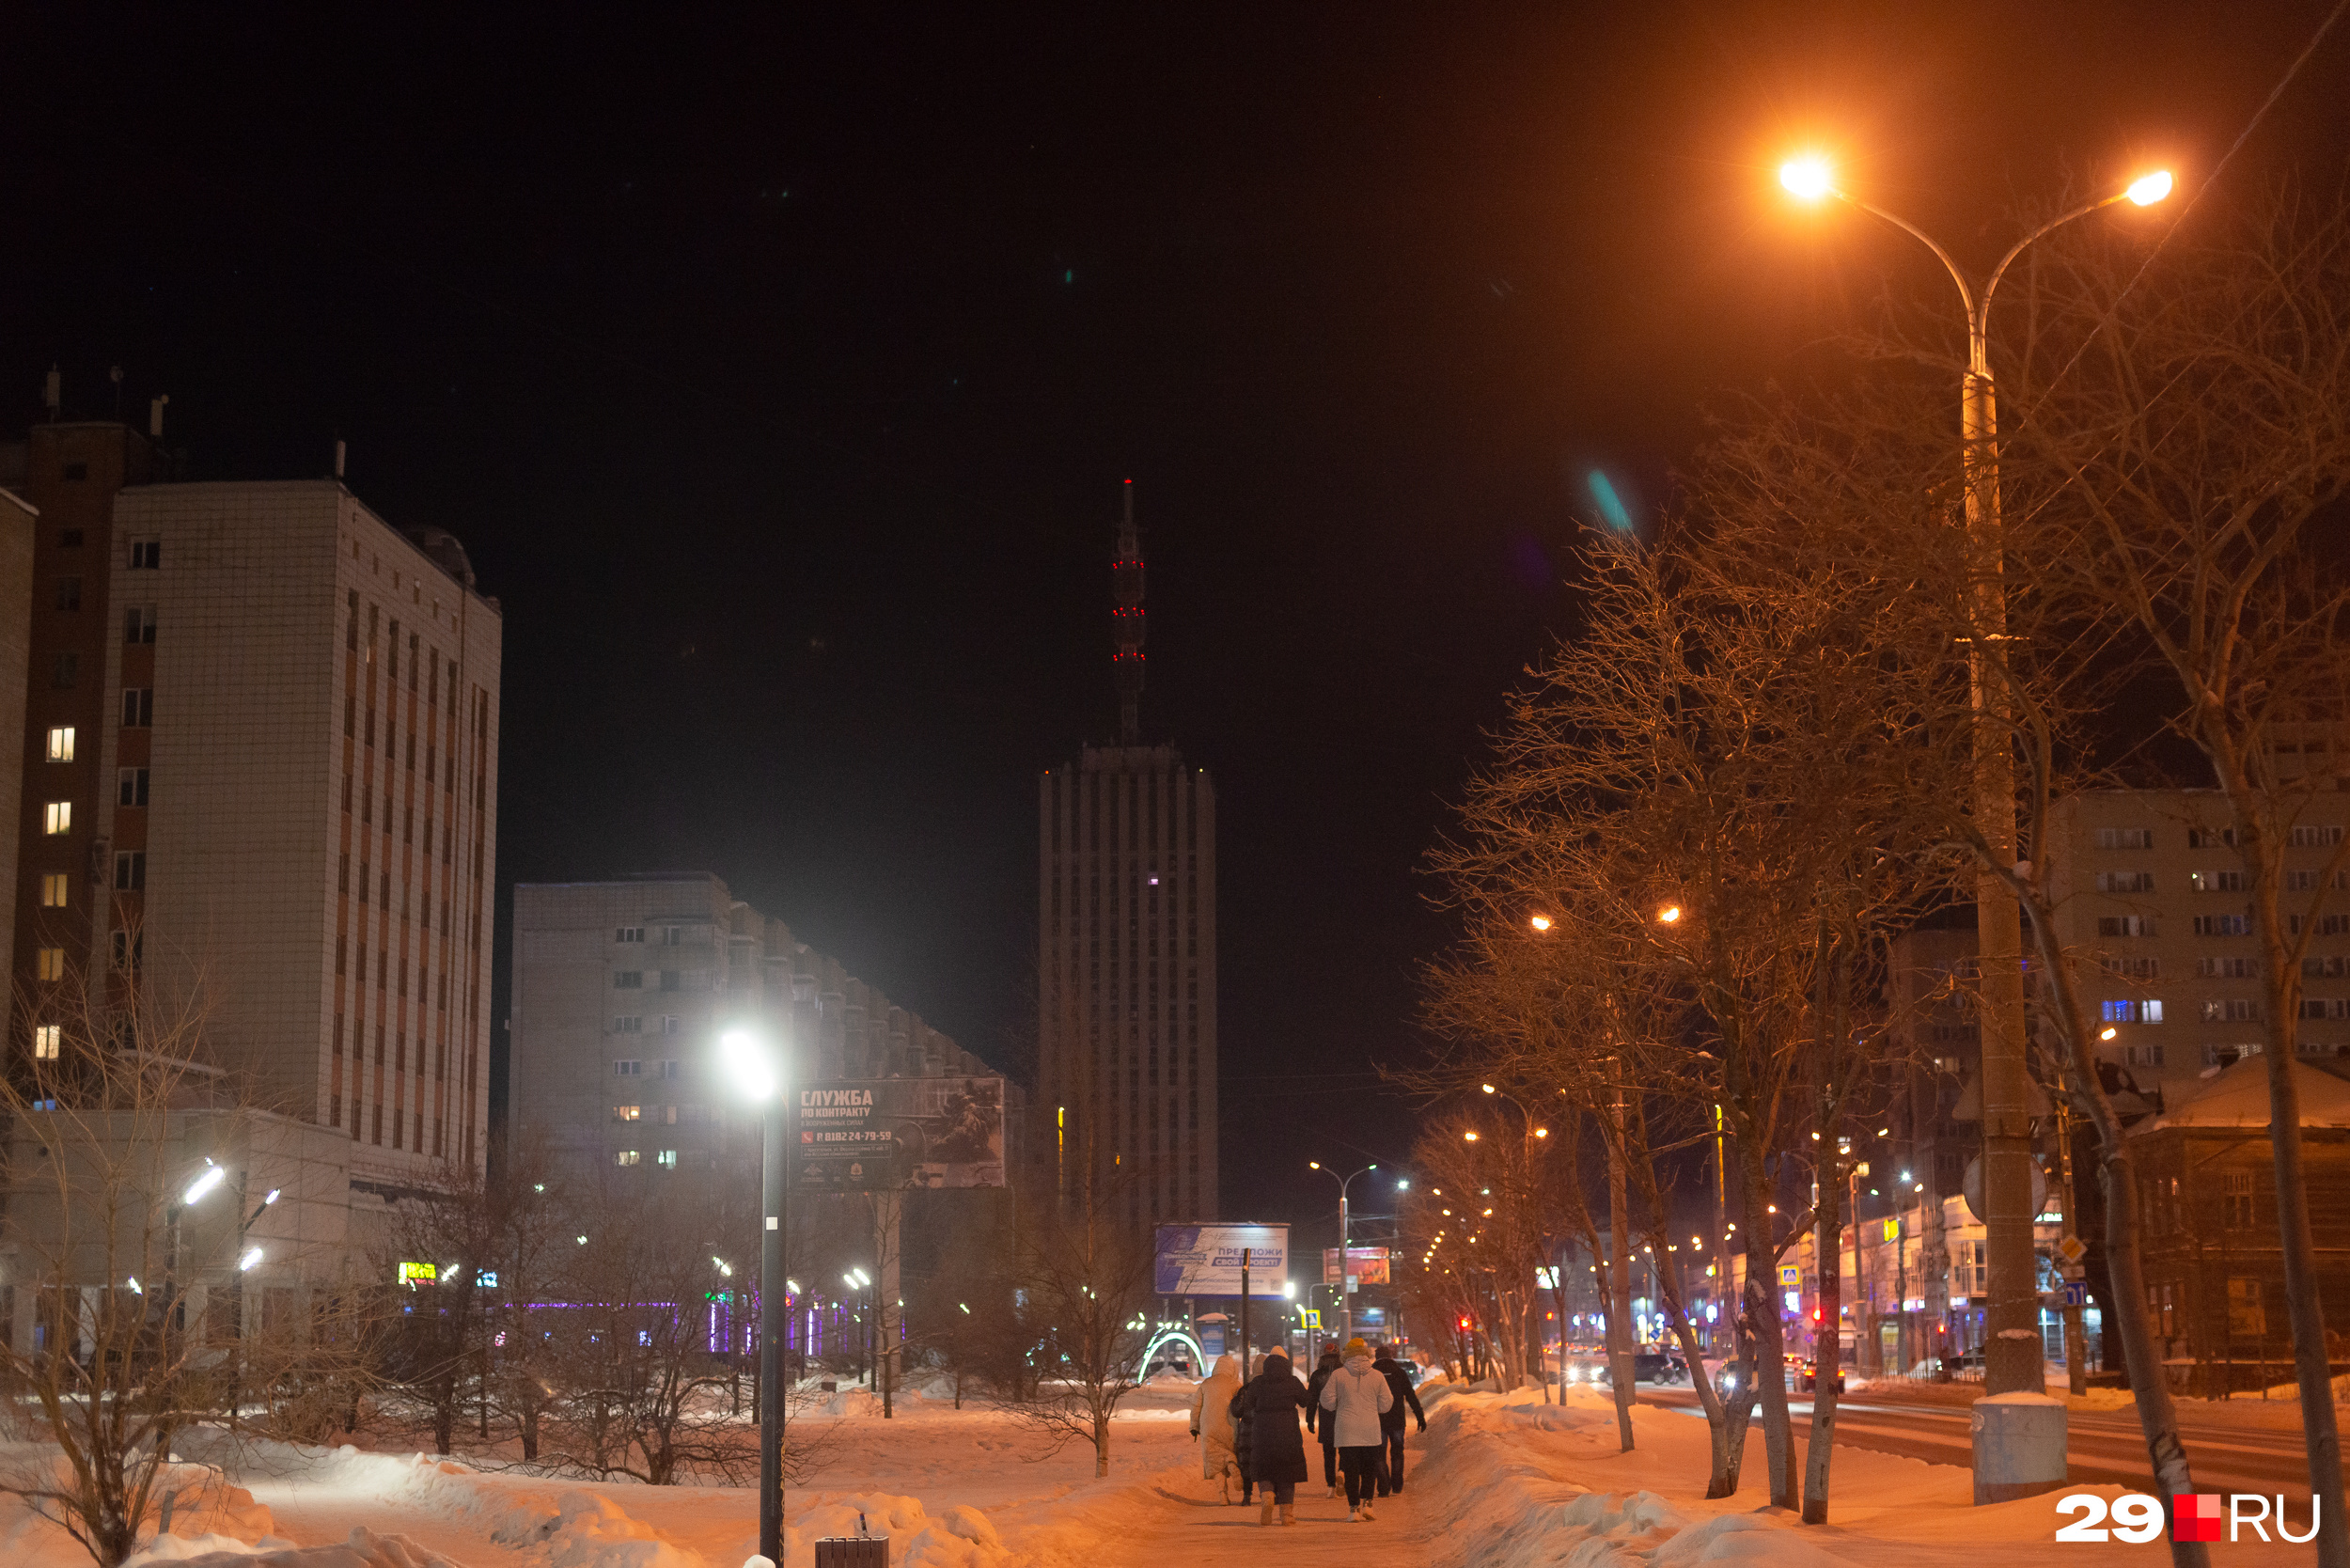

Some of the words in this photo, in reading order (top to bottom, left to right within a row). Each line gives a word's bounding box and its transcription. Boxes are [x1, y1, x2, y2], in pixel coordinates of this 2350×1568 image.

[801, 1090, 873, 1106] СЛУЖБА
[801, 1107, 814, 1118] ПО
[816, 1107, 870, 1118] КОНТРАКТУ
[824, 1132, 847, 1141] 8182
[849, 1131, 892, 1141] 24-79-59
[1215, 1258, 1240, 1266] СВОЙ
